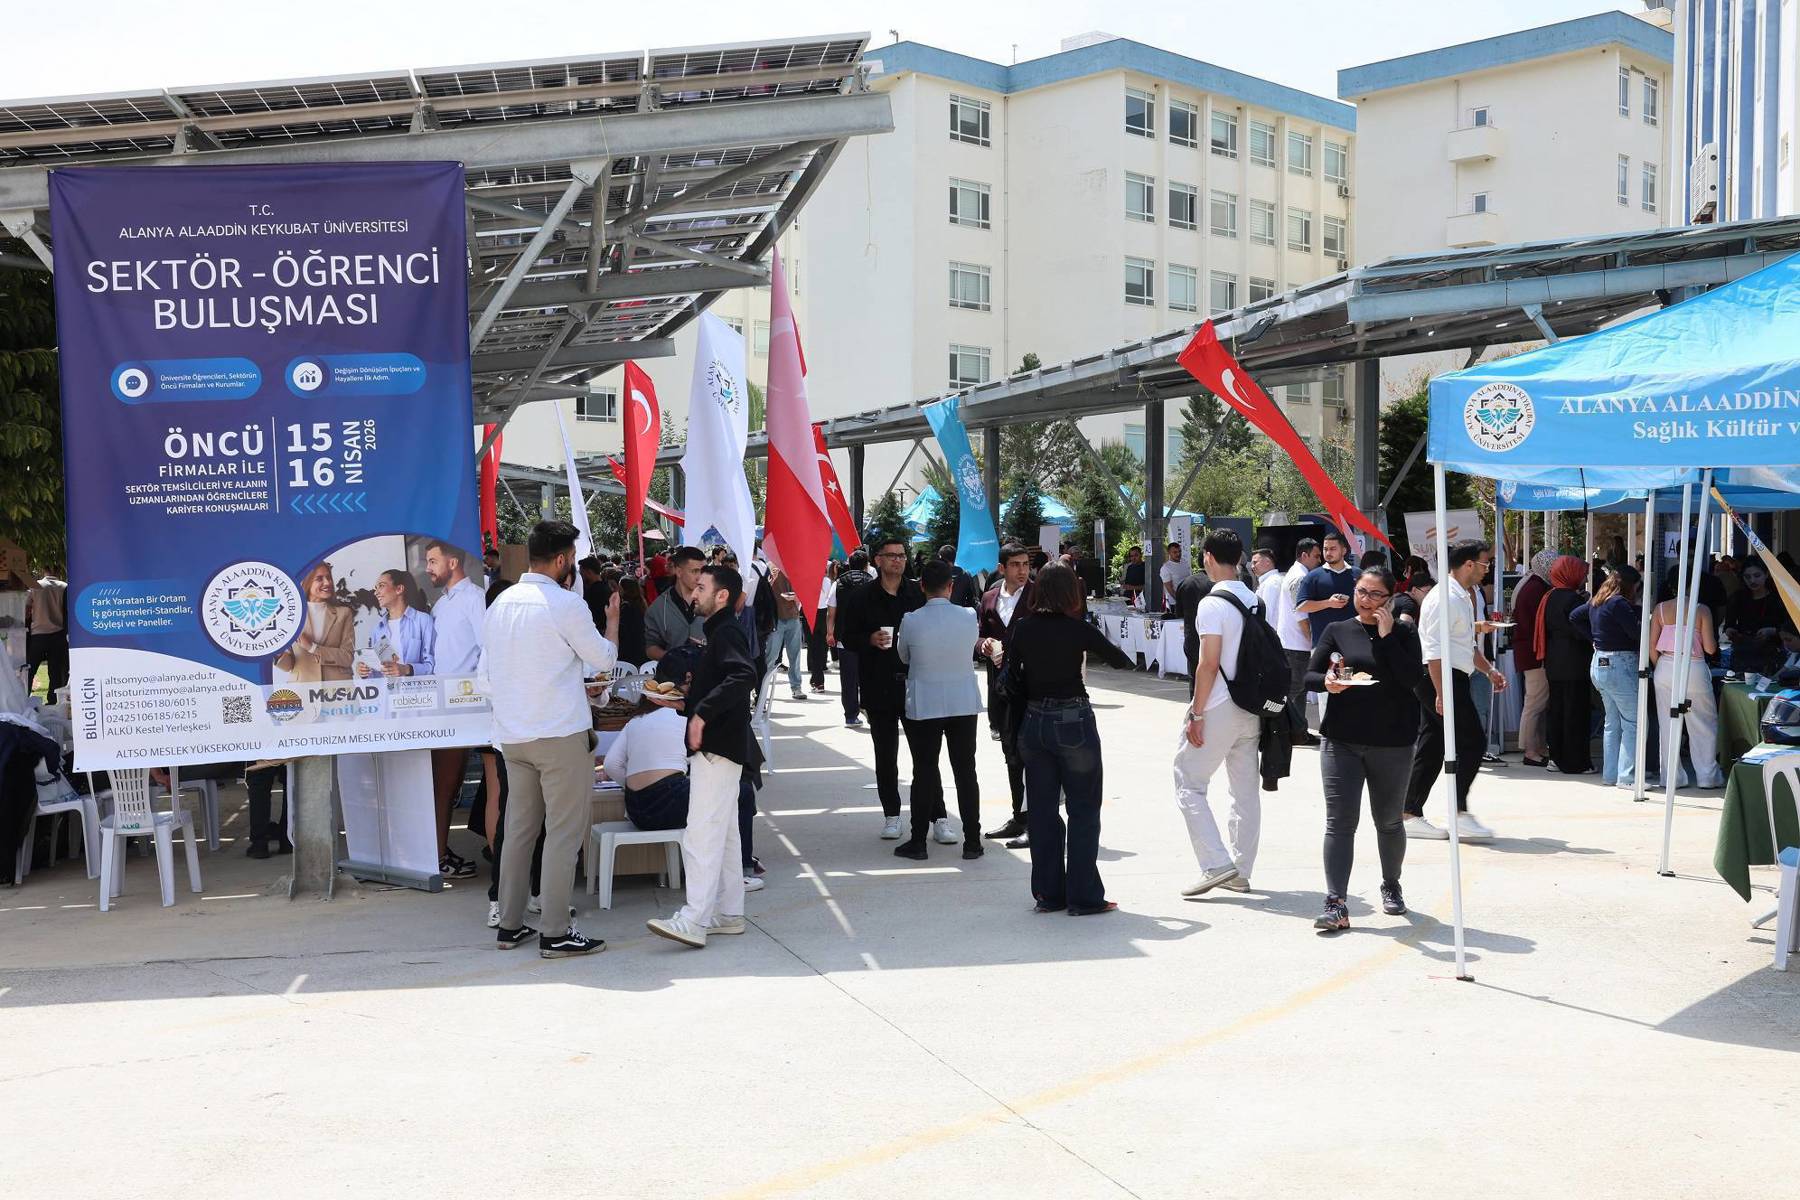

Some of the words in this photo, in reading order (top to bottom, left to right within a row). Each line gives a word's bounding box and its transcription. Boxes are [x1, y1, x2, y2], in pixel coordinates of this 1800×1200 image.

[249, 204, 275, 217] T.C.
[119, 225, 174, 239] ALANYA
[179, 221, 247, 238] ALAADDİN
[251, 221, 320, 236] KEYKUBAT
[323, 218, 409, 234] ÜNİVERSİTESİ
[87, 252, 242, 294] SEKTÖR
[272, 246, 440, 288] ÖĞRENCİ
[153, 293, 379, 334] BULUŞMASI
[160, 382, 177, 390] Öncü
[1559, 396, 1659, 414] ALANYA
[287, 422, 333, 453] 15
[363, 419, 376, 451] 2026
[1632, 420, 1700, 444] Sağlık
[1706, 418, 1783, 439] Kültür
[164, 424, 264, 459] ÖNCÜ
[340, 421, 363, 484] NİSAN
[159, 462, 238, 478] FİRMALAR
[242, 459, 266, 474] İLE
[289, 457, 335, 487] 16
[125, 483, 160, 494] SEKTÖR
[161, 480, 221, 492] TEMSİLCİLERİ
[222, 481, 233, 490] VE
[235, 480, 268, 489] ALANIN
[129, 493, 205, 505] UZMANLARINDAN
[206, 490, 268, 502] ÖĞRENCİLERE
[166, 504, 203, 515] KARİYER
[205, 502, 269, 514] KONUŞMALARI
[92, 597, 111, 607] Fark
[112, 596, 145, 606] Yaratan
[146, 595, 158, 604] Bir
[159, 594, 187, 603] Ortam
[208, 587, 222, 627] ALANYA
[221, 567, 274, 587] ALAADDİN
[272, 575, 296, 623] KEYKUBAT
[92, 609, 100, 619] İş
[93, 619, 124, 630] Söyleşi
[137, 618, 173, 627] Paneller.
[220, 628, 289, 651] ÜNİVERSİTESİ
[105, 671, 217, 686] altsomyo@alanya.edu.tr
[81, 678, 98, 703] İÇİN
[105, 682, 247, 698] altsoturizmmyo@alanya.edu.tr
[105, 697, 197, 711] 02425106180/6015
[82, 708, 97, 740] BİLGİ
[106, 710, 198, 724] 02425106185/6215
[135, 724, 164, 735] Kestel
[166, 722, 212, 734] Yerleşkesi
[277, 737, 309, 749] ALTSO
[310, 734, 347, 746] TURİZM
[349, 732, 386, 744] MESLEK
[387, 727, 456, 741] YÜKSEKOKULU
[116, 748, 148, 759] ALTSO
[150, 746, 190, 757] MESLEK
